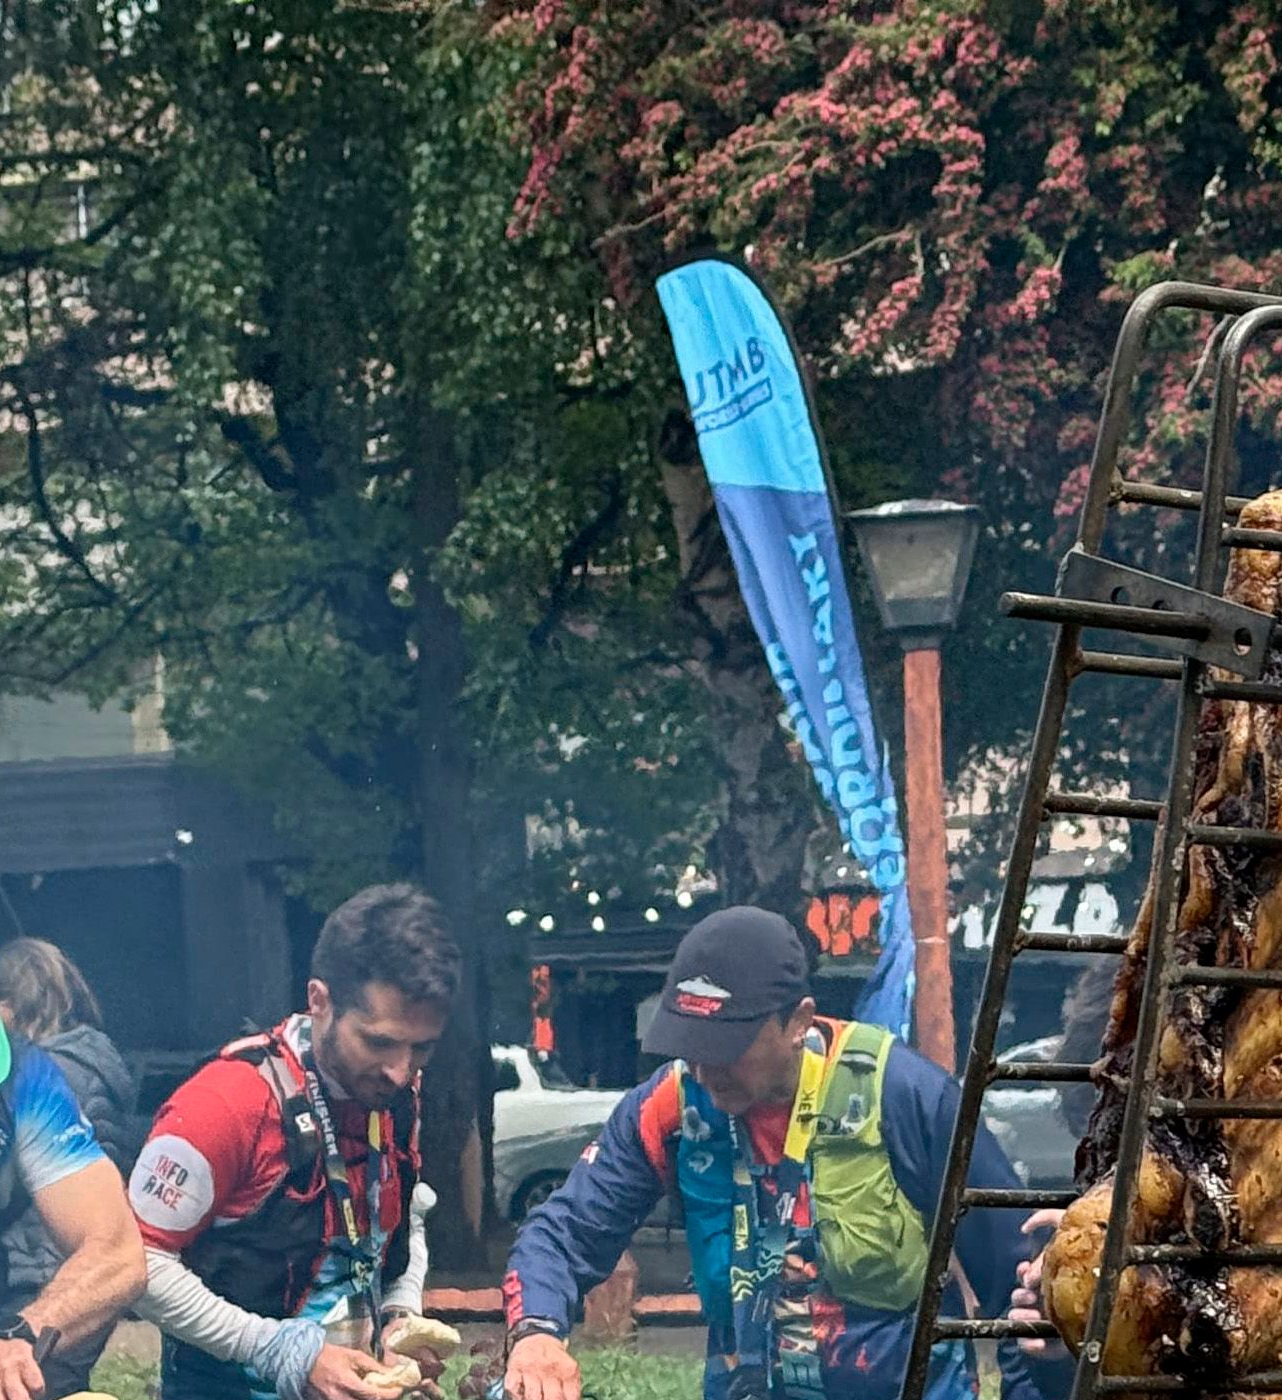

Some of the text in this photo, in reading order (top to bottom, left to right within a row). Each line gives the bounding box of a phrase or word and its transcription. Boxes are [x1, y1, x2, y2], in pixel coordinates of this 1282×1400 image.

[305, 1069, 340, 1157] FINISHER
[155, 1154, 189, 1187] INFO
[141, 1174, 184, 1211] RACE
